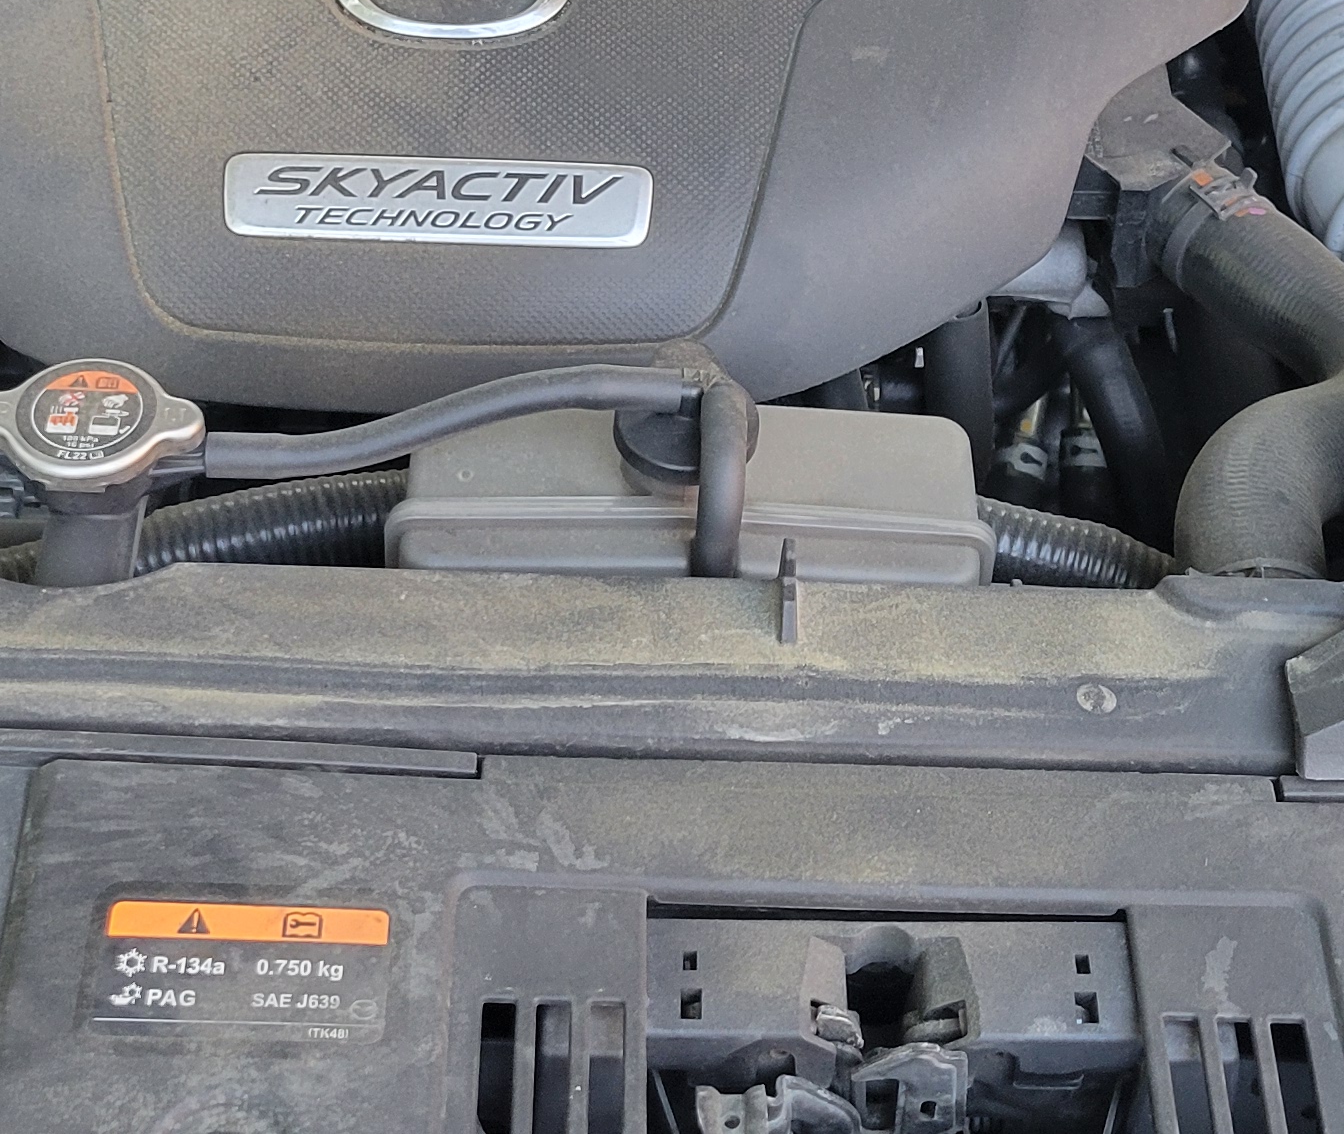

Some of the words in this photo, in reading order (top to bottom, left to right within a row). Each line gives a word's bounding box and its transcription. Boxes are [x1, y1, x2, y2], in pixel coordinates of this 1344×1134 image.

[254, 166, 623, 206] SKYACTIV
[293, 205, 573, 233] TECHNOLOGY
[56, 450, 87, 460] FL22
[150, 956, 226, 977] R-134a
[256, 959, 312, 978] 0.750
[318, 960, 345, 981] kg
[145, 989, 196, 1008] PAG
[251, 993, 291, 1008] SAE
[295, 993, 341, 1010] J639
